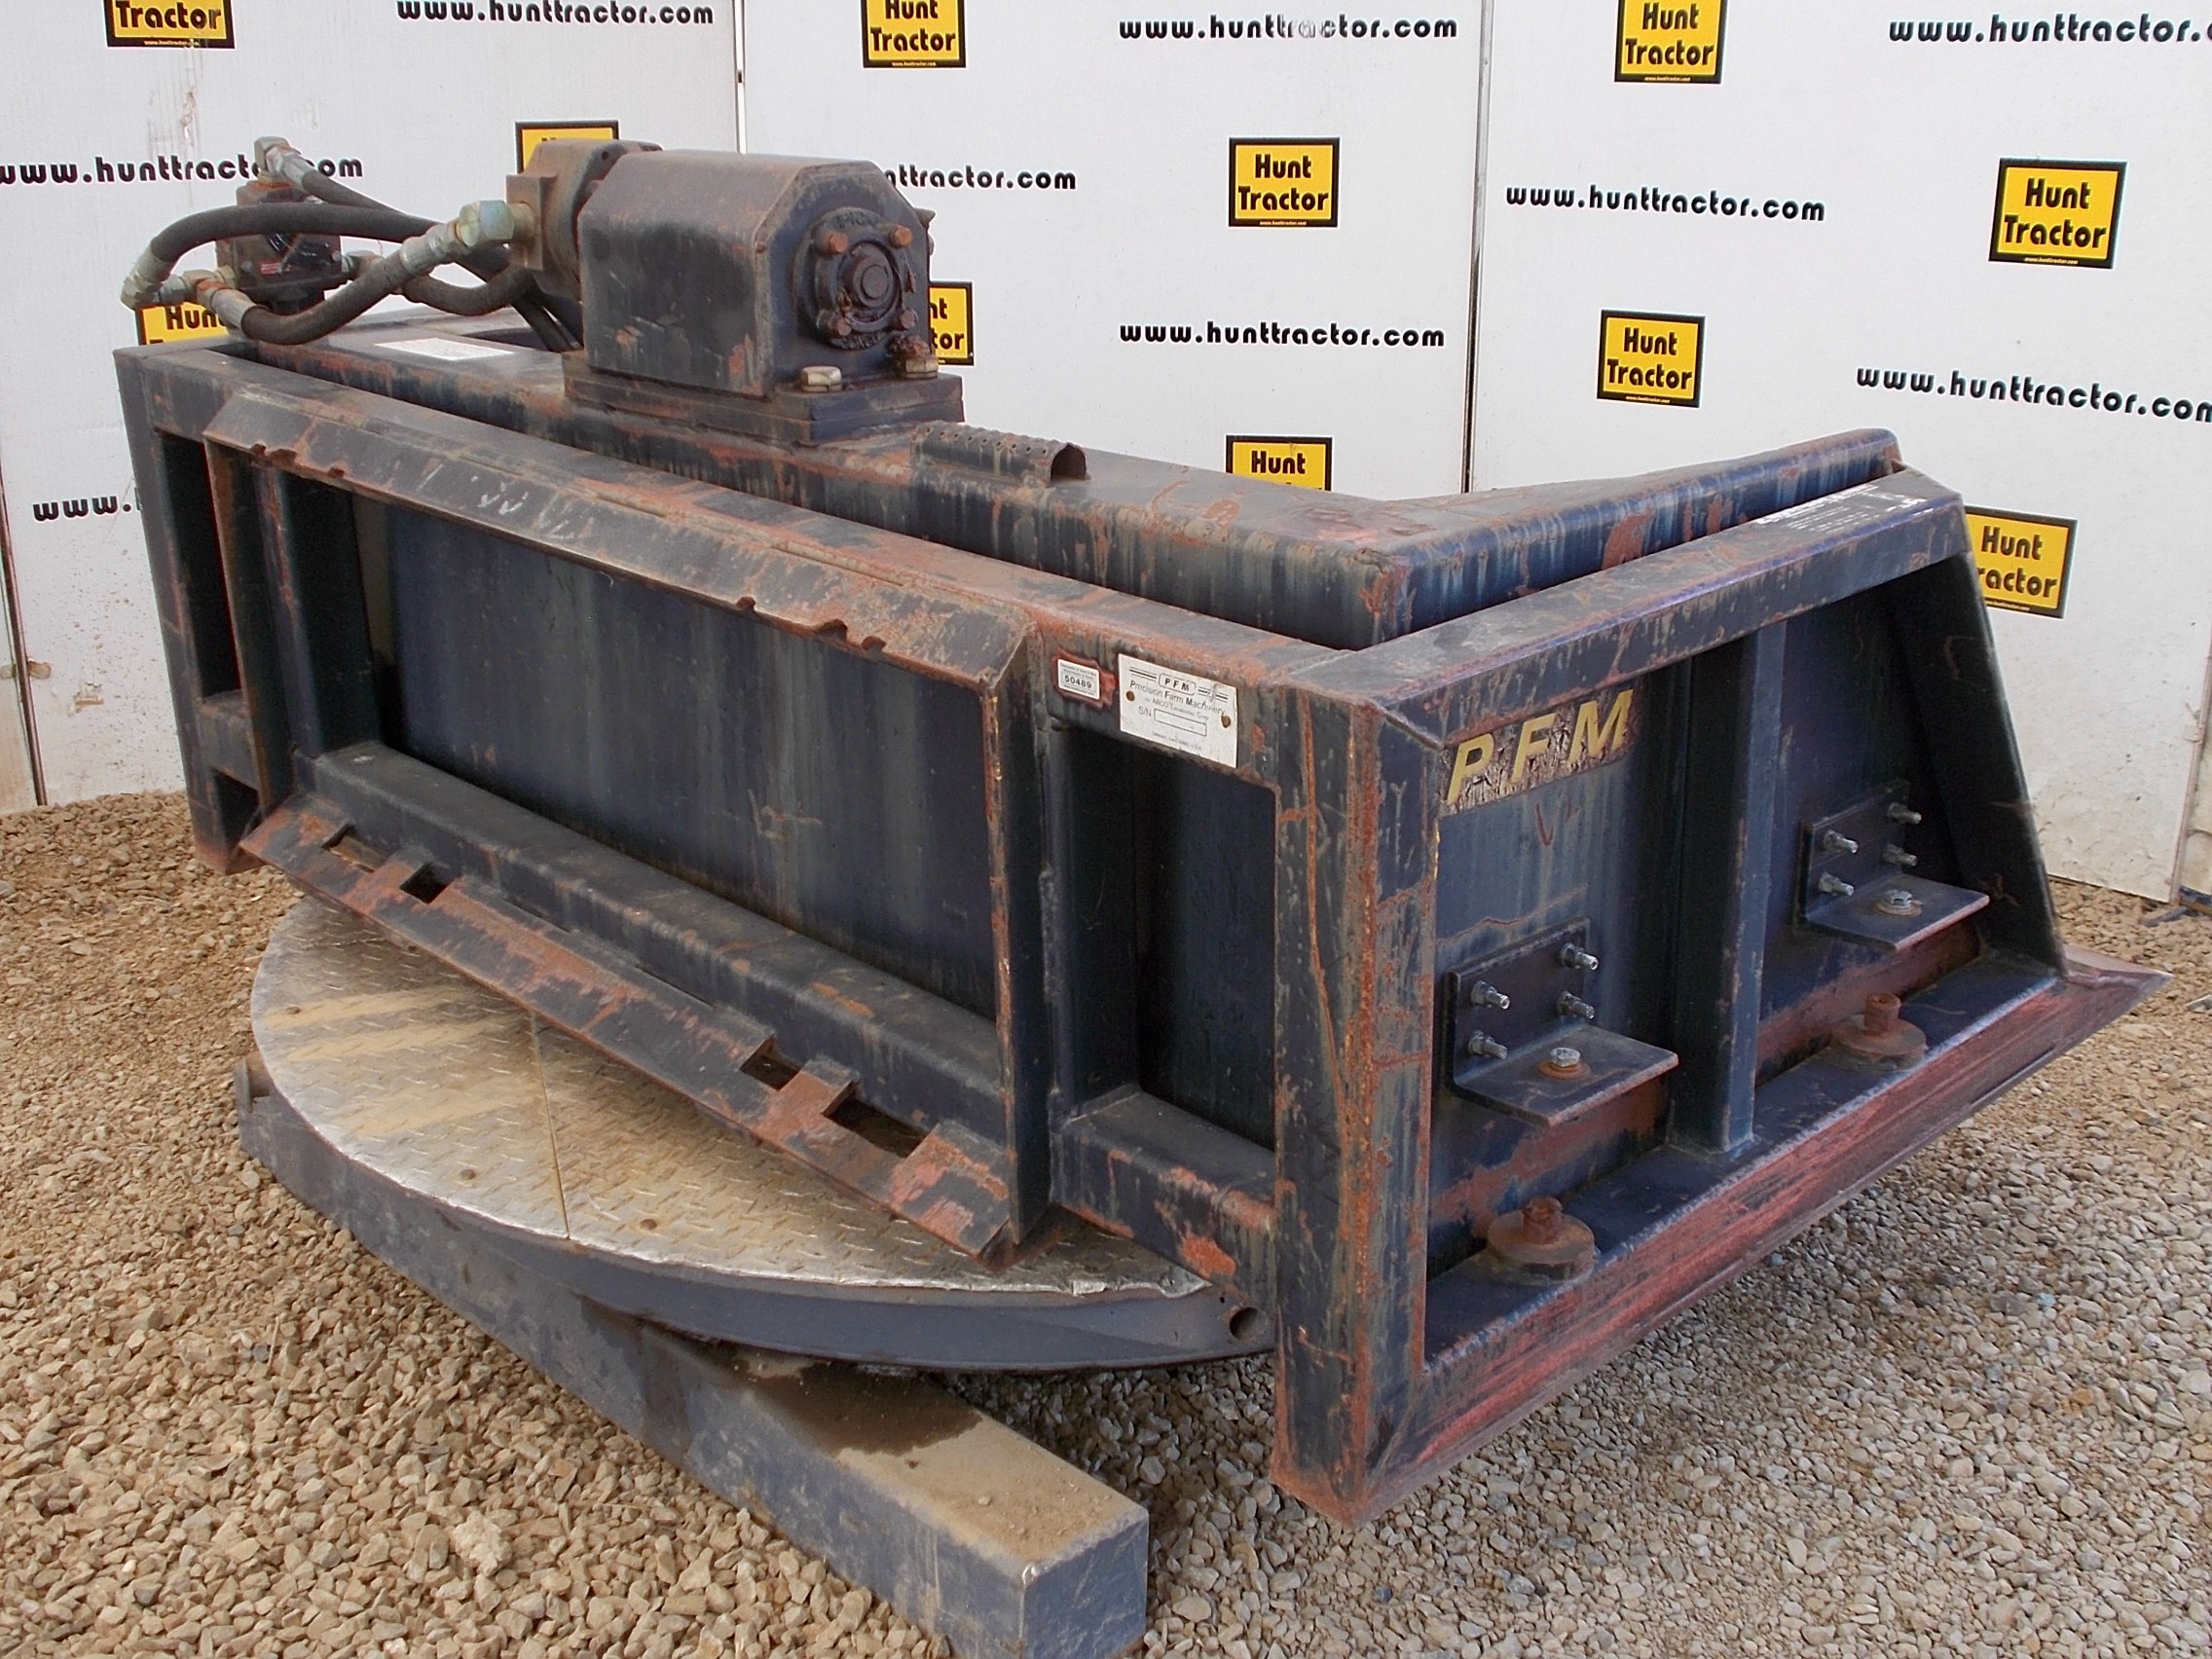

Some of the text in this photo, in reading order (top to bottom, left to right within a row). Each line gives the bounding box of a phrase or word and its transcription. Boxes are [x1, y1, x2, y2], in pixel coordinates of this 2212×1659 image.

[115, 1, 222, 29] Tractor
[396, 0, 714, 24] www.hunttractor.com
[885, 0, 938, 19] Hunt
[1641, 2, 1699, 30] Hunt
[869, 26, 956, 52] Tractor
[1119, 14, 1457, 40] www.hunttractor.com
[1889, 15, 2212, 42] www.hunttractor.
[1625, 37, 1714, 66] Tractor
[0, 153, 363, 184] www.hunttractom
[885, 165, 1076, 190] nttractor.com
[1255, 153, 1311, 179] Hunt
[1238, 185, 1329, 211] Tractor
[1506, 184, 1825, 222] www.hunttractor.com
[2024, 177, 2091, 209] Hunt
[2004, 214, 2107, 248] Tractor
[165, 304, 227, 330] Hun
[1120, 320, 1445, 347] www.hunttractor.com
[1623, 326, 1677, 355] Hunt
[1606, 357, 1692, 390] Tractor
[1251, 450, 1307, 474] Hunt
[1980, 525, 2043, 561] Hunt
[1976, 566, 2058, 598] ractor
[1064, 675, 1092, 689] 50489
[1129, 680, 1226, 718] Precision Farm Machinery
[1138, 706, 1152, 718] S/N
